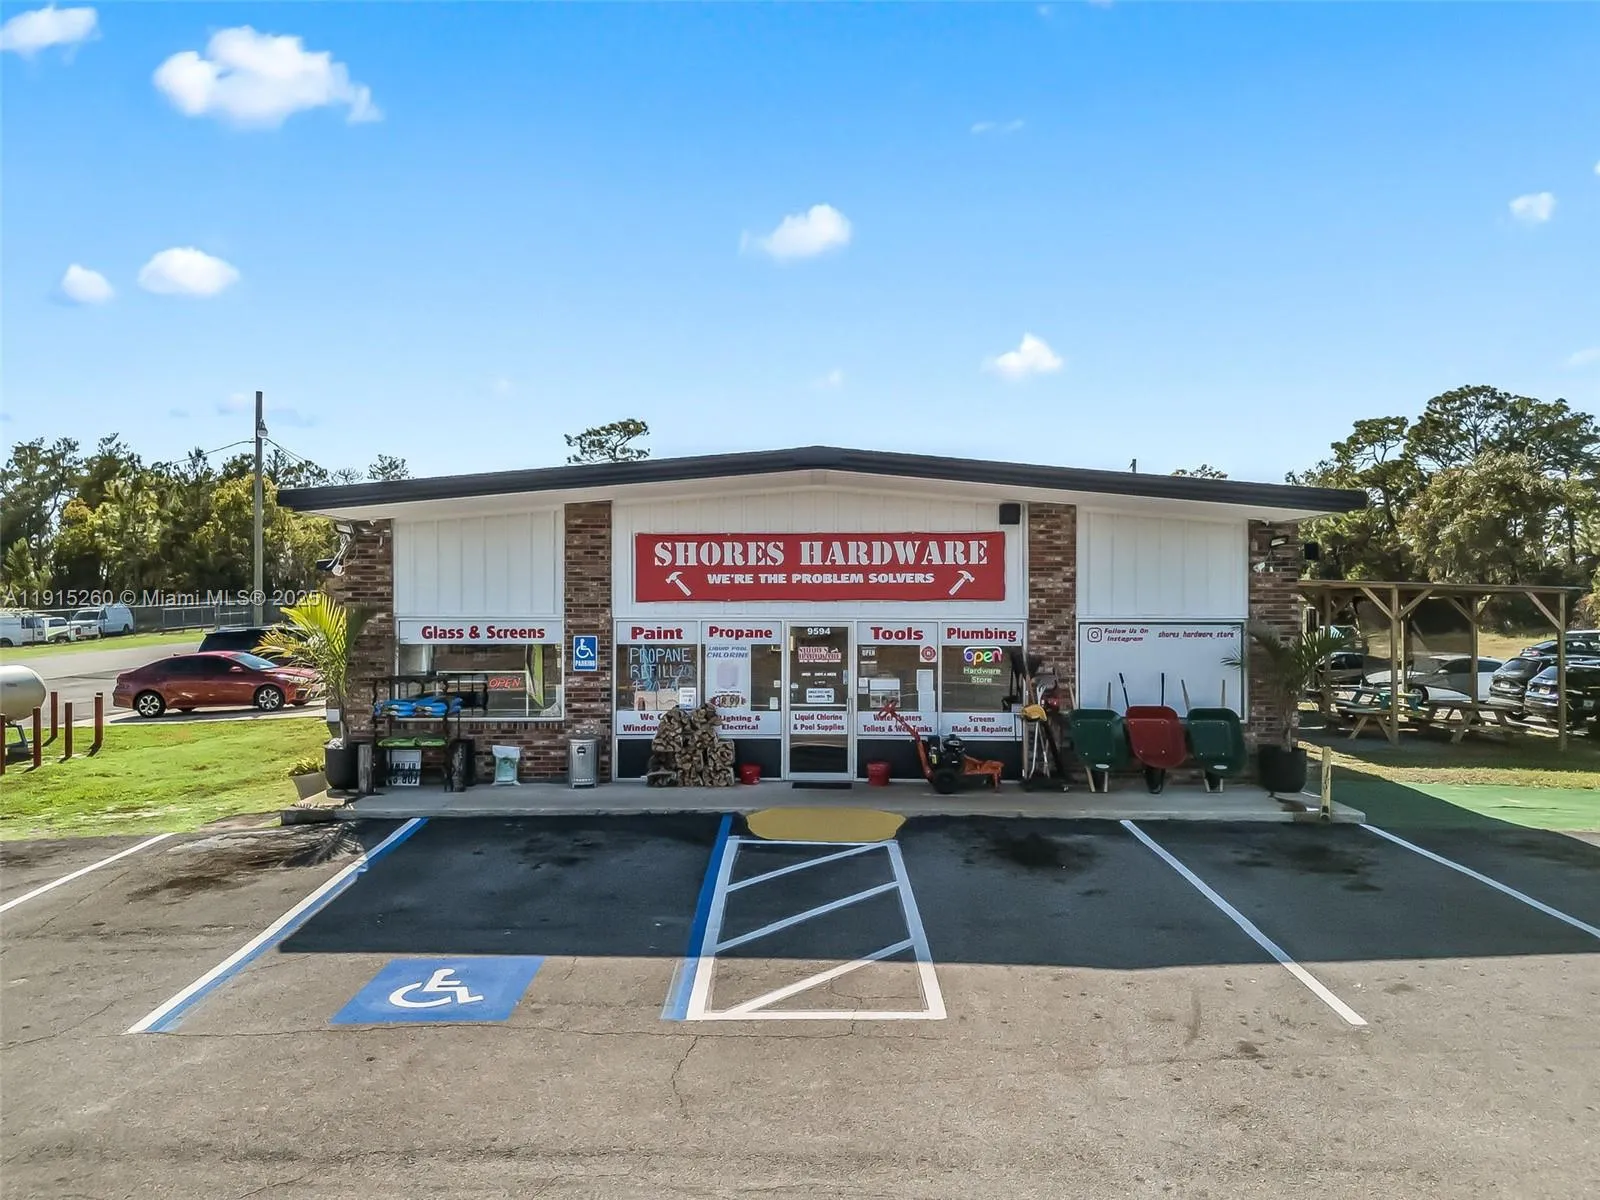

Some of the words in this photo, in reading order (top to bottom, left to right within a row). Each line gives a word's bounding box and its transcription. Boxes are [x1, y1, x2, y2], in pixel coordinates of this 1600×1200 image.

[654, 541, 785, 567] SHORES
[799, 540, 988, 566] HARDWARE
[707, 573, 754, 585] WE'RE
[758, 573, 787, 585] THE
[791, 573, 864, 585] PROBLEM
[868, 573, 935, 585] SOLVERS
[421, 625, 465, 639] Glass
[468, 625, 481, 639] &
[486, 625, 546, 639] Screens
[631, 626, 684, 640] Paint
[708, 625, 774, 641] Propane
[807, 627, 831, 636] 9594
[870, 626, 924, 641] Tools
[946, 627, 1017, 642] Plumbing
[1104, 627, 1127, 635] Follow
[1128, 627, 1138, 635] Us
[1107, 635, 1144, 643] Instagram
[629, 647, 692, 665] PROPANE
[964, 650, 1002, 667] open
[630, 664, 677, 679] REFILL
[963, 667, 1002, 676] Hardware
[488, 678, 521, 688] OPEN
[971, 676, 993, 684] Store
[640, 713, 655, 721] We
[794, 714, 815, 722] Liquid
[816, 713, 843, 721] Chlorine
[968, 715, 996, 723] Screens
[816, 724, 845, 733] Supplies
[863, 725, 886, 733] Toilets
[981, 726, 1013, 734] Repaired
